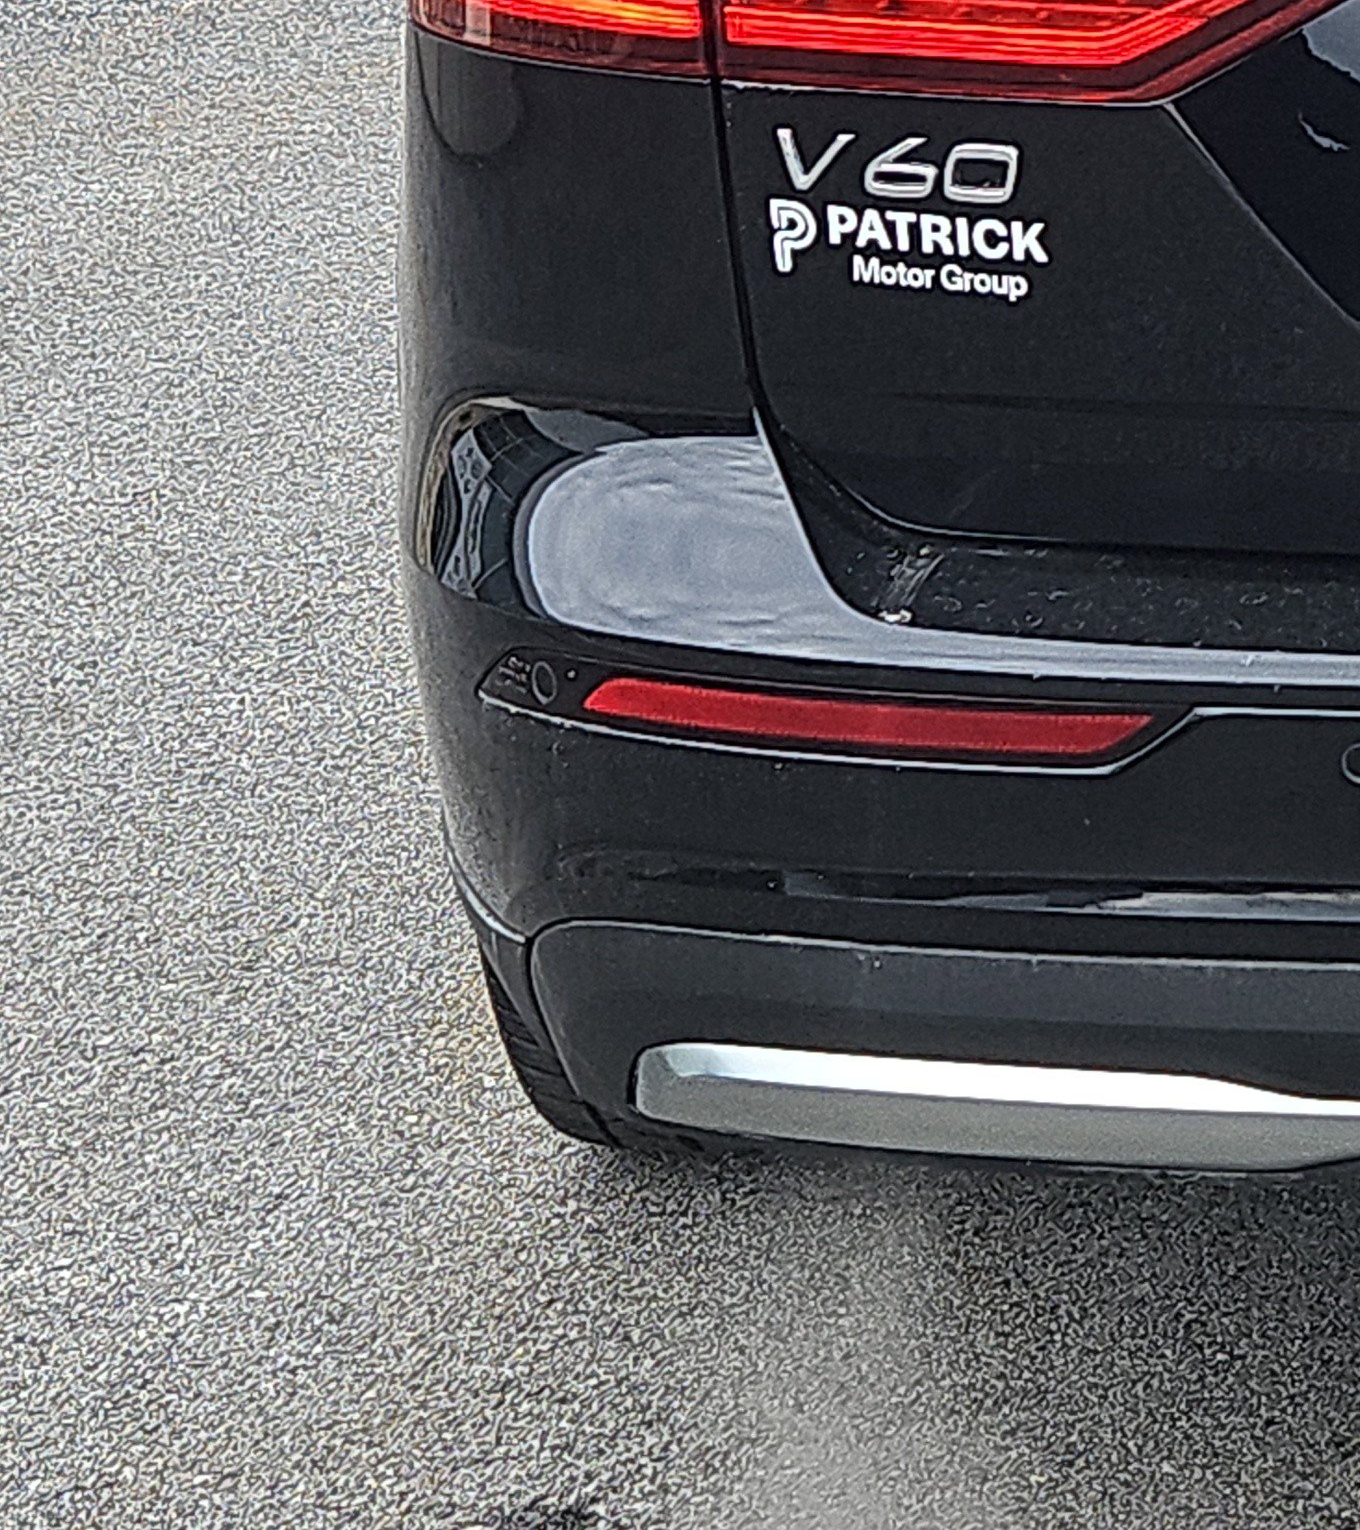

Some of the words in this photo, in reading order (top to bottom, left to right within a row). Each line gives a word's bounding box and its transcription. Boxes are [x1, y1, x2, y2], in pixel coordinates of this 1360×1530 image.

[776, 127, 1020, 204] V60
[826, 204, 1050, 264] PATRICK
[852, 255, 936, 290] Motor
[940, 263, 1030, 302] Group
